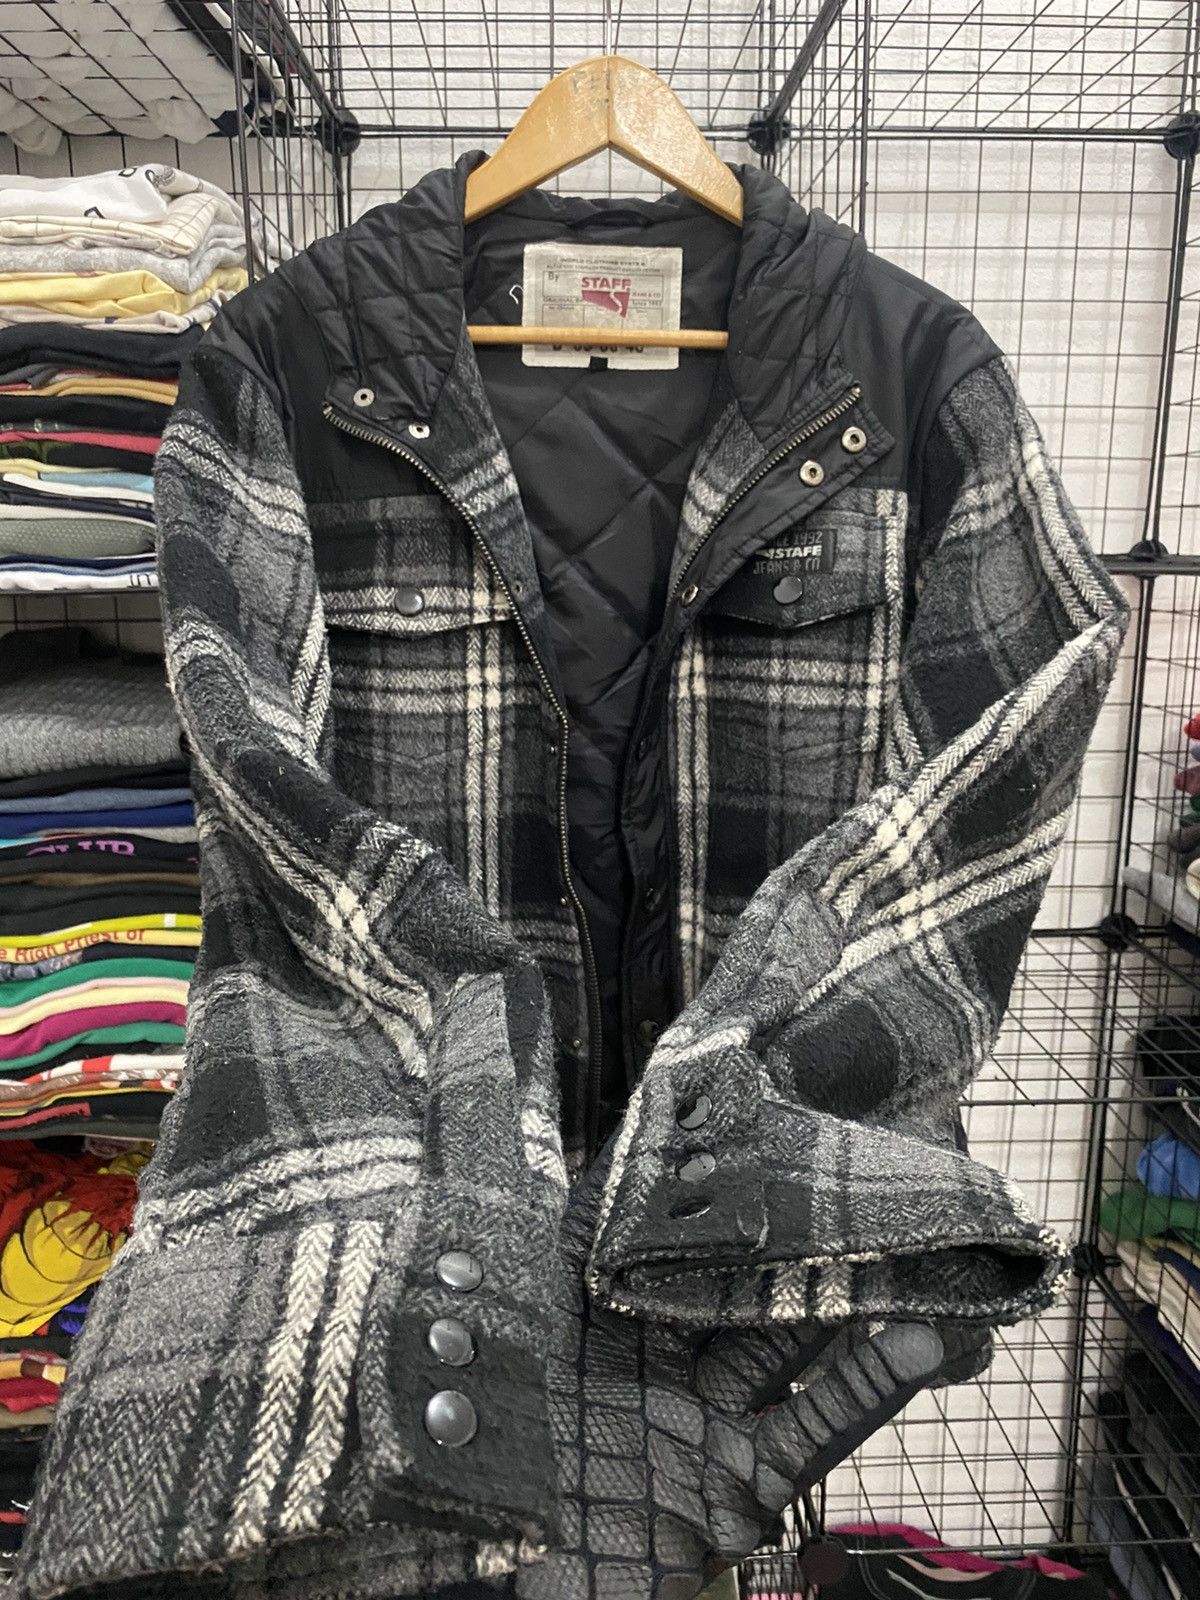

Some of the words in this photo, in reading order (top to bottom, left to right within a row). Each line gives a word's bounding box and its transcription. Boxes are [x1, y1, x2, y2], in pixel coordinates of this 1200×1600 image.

[548, 271, 560, 282] By
[581, 276, 631, 290] STAFF
[793, 530, 823, 546] 1992
[774, 544, 823, 560] STAFF
[752, 559, 790, 575] JEANS
[64, 930, 119, 953] Priest
[126, 930, 145, 942] of
